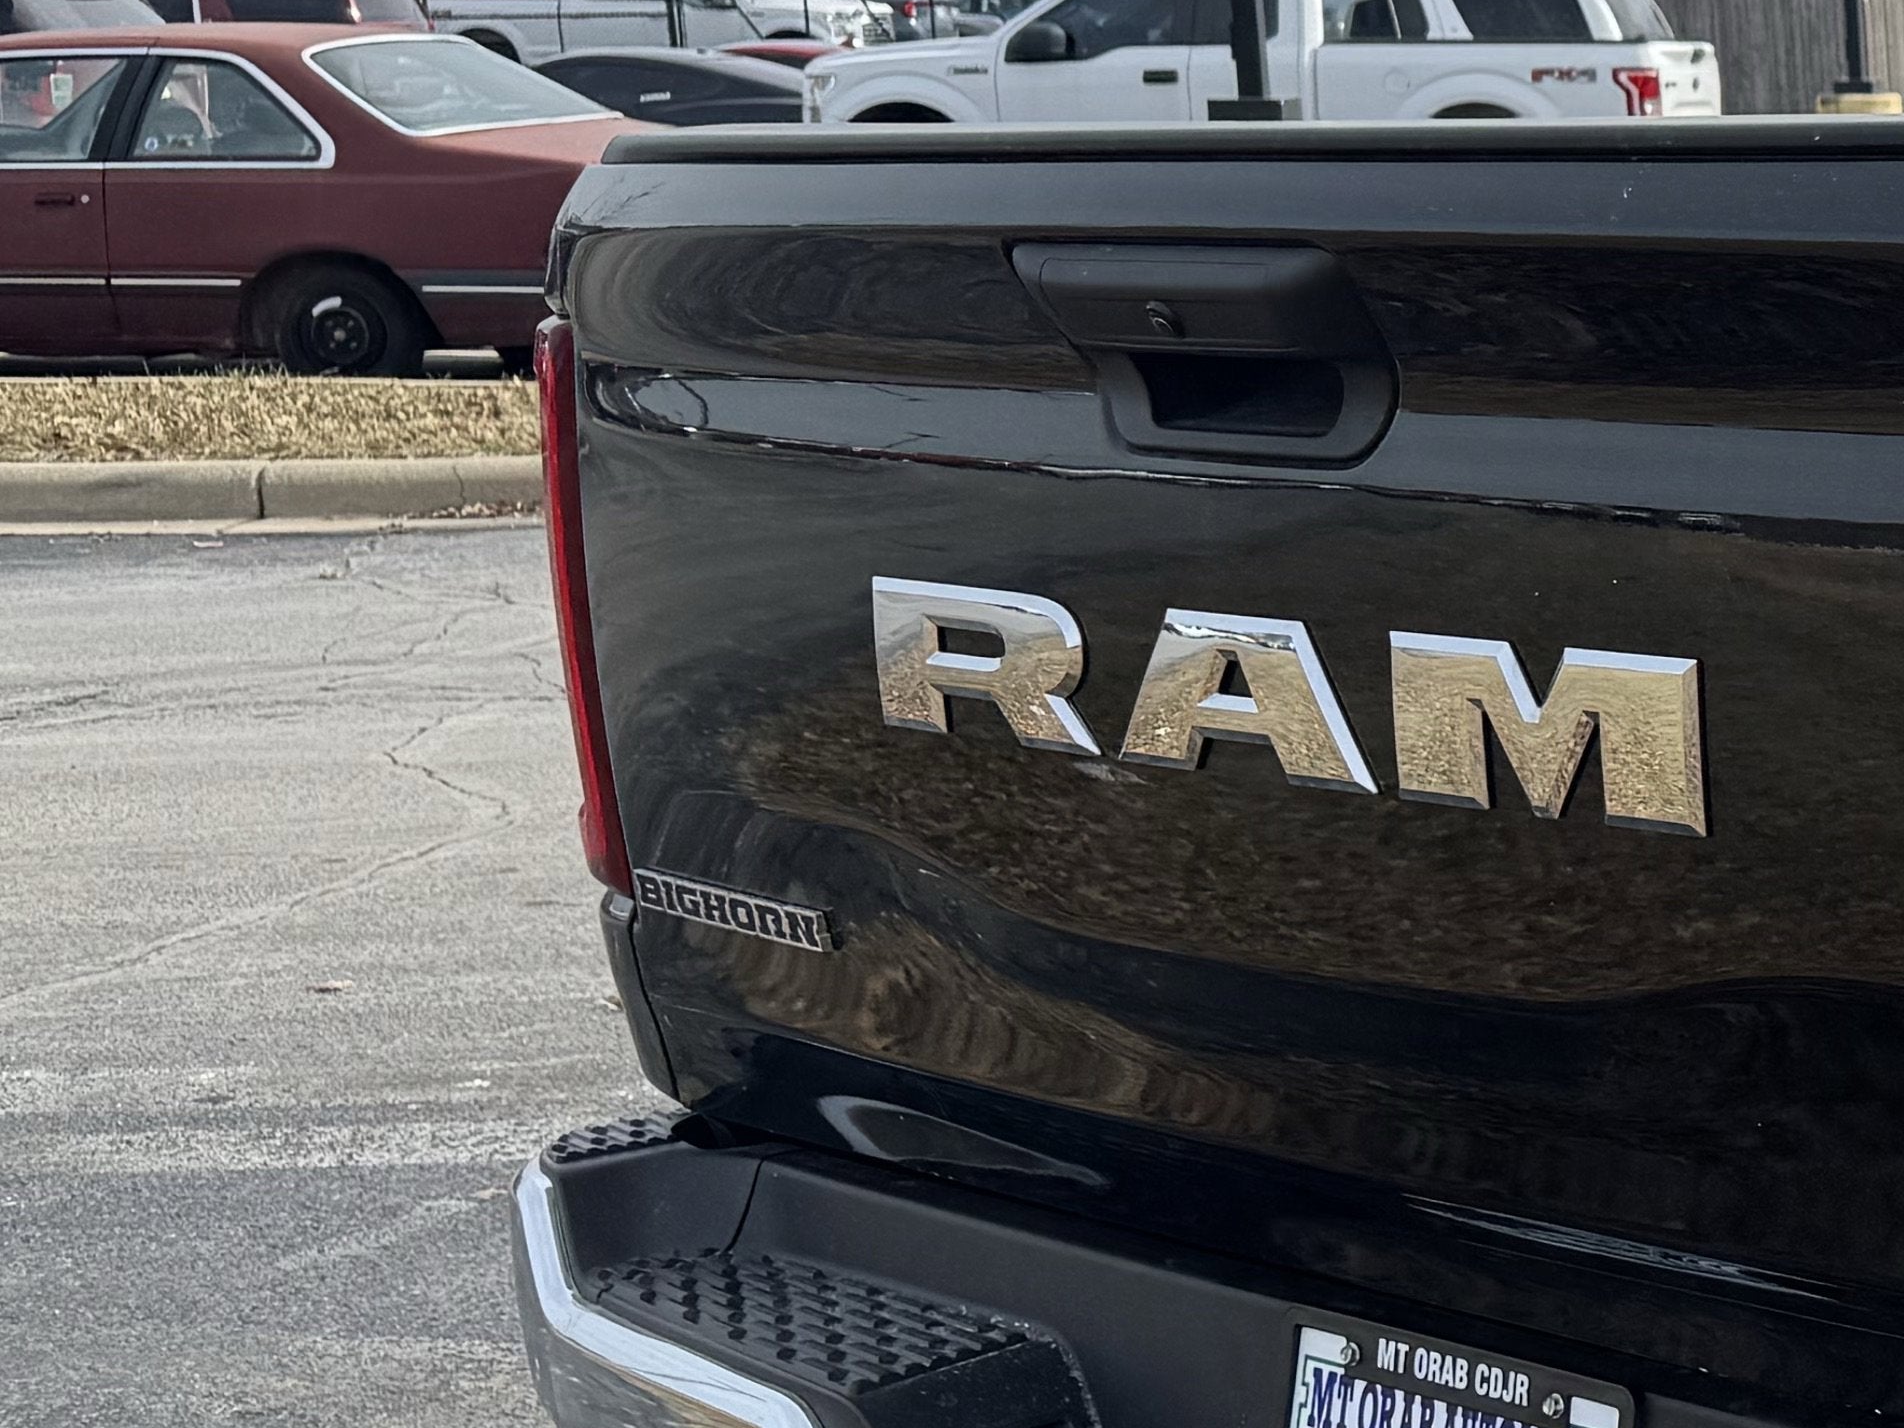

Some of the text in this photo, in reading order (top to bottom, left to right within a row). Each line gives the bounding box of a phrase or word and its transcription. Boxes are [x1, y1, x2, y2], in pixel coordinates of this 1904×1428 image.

[872, 575, 1709, 839] RAM
[634, 869, 832, 952] BIGHORN
[1377, 1338, 1530, 1407] MT ORAB CDJR
